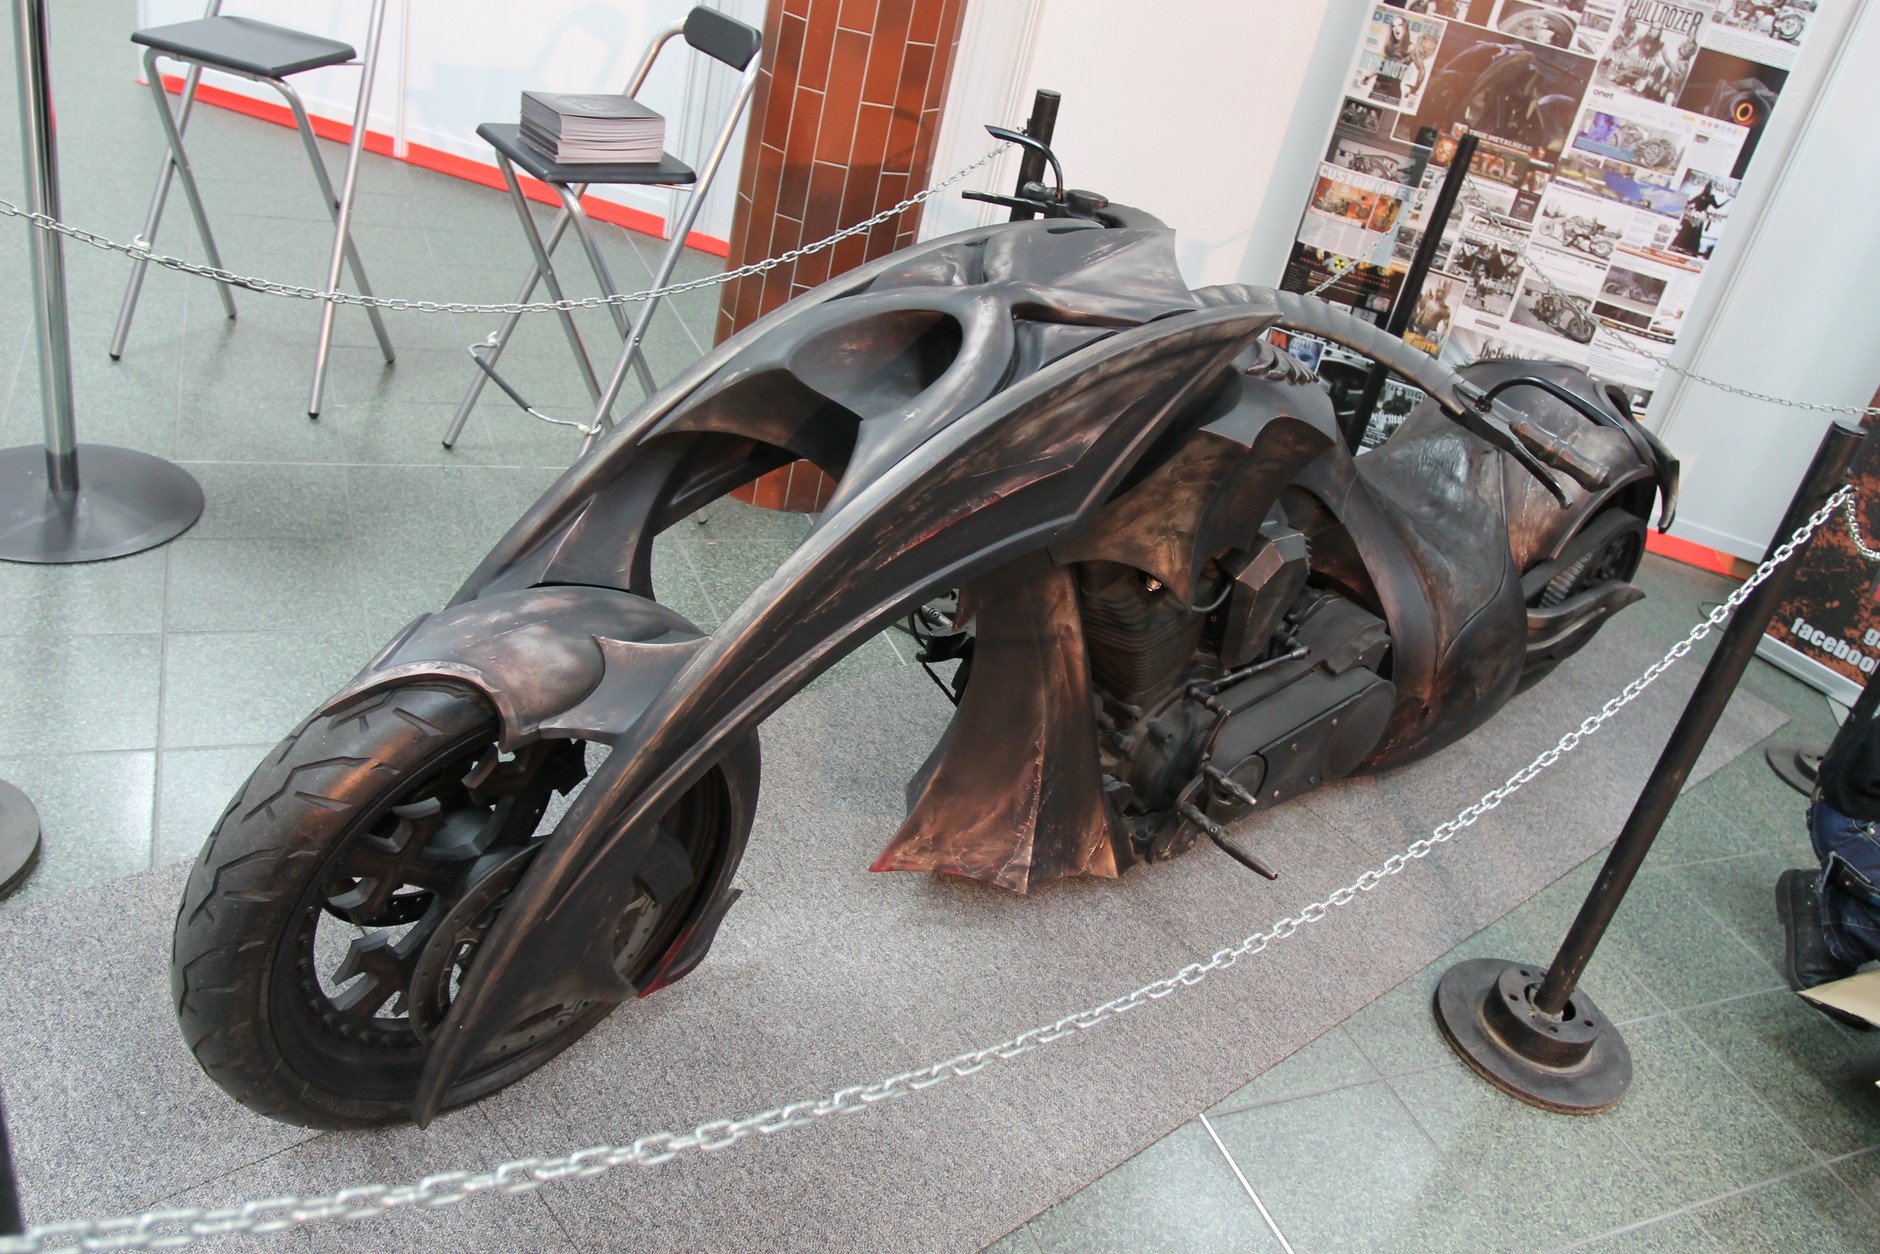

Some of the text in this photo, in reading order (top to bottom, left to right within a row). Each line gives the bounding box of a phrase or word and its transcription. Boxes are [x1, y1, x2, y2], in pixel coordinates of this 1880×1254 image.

[1592, 88, 1614, 99] onet
[1487, 133, 1534, 152] METALHEAD
[1470, 149, 1519, 181] ETAL
[1790, 617, 1880, 676] faceboo
